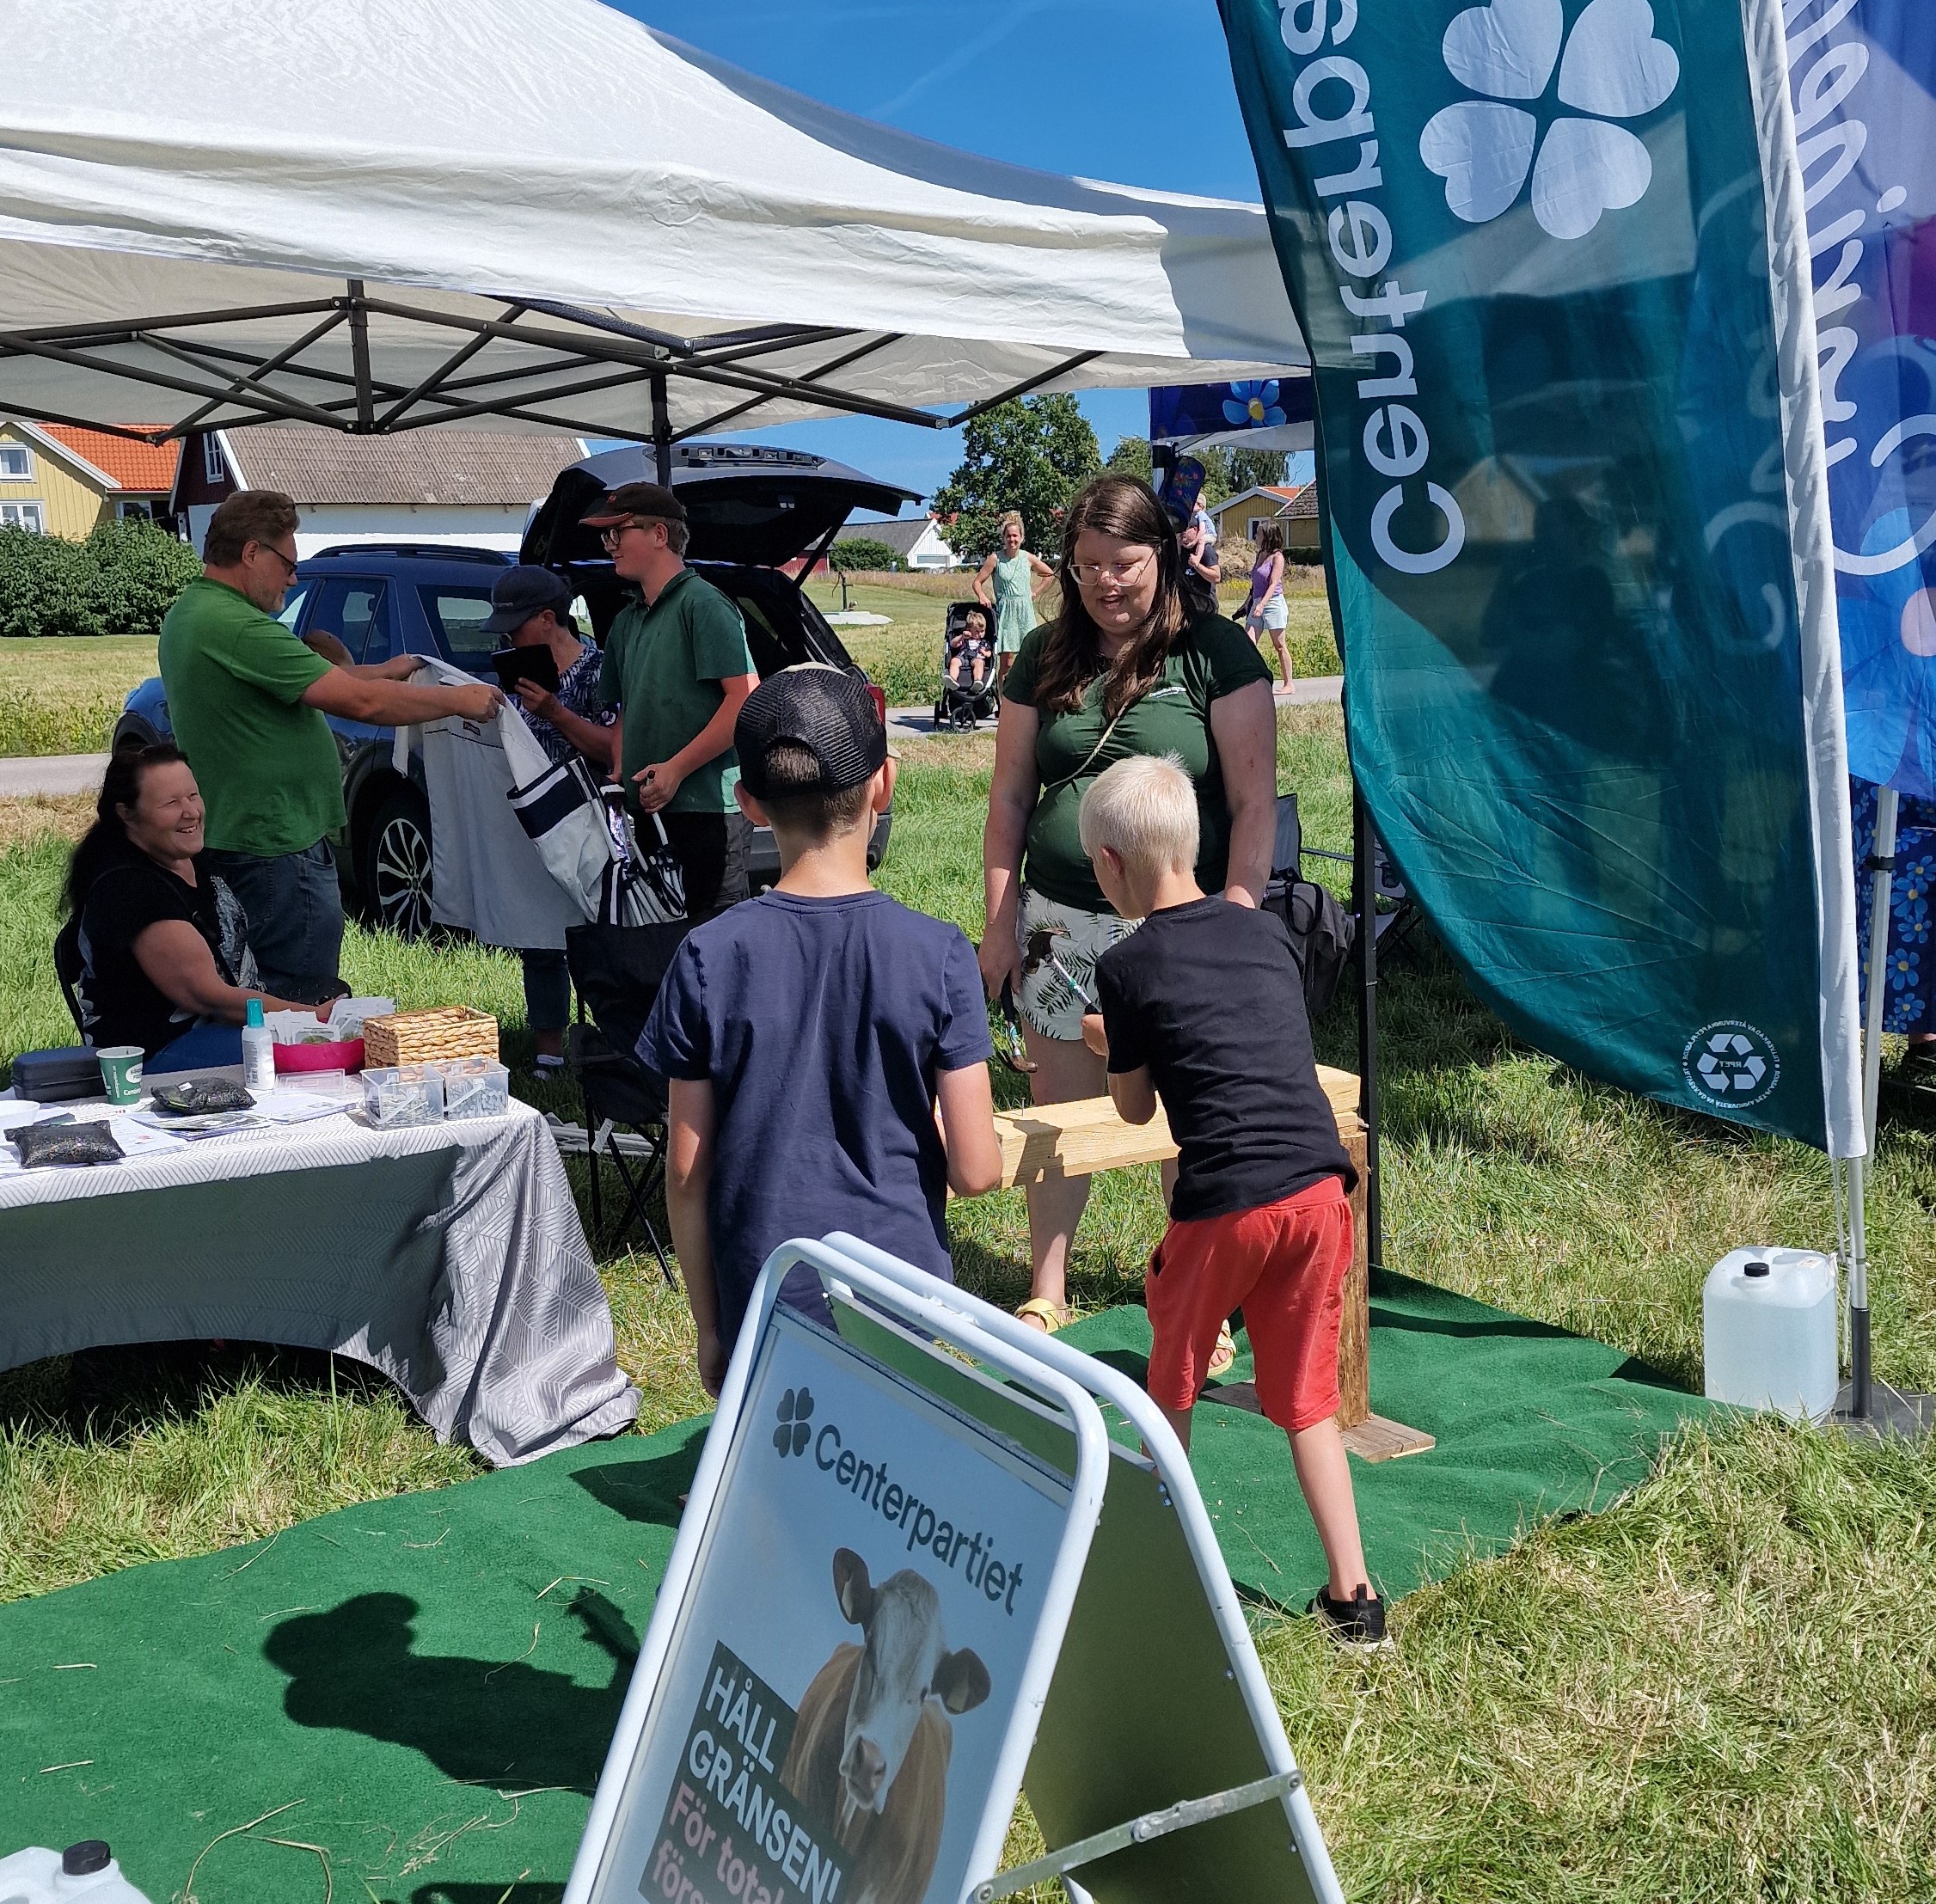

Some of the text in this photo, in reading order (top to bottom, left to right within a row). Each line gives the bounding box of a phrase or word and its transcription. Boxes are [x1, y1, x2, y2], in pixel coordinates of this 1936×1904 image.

[814, 1423, 1023, 1616] Centerpartiet
[705, 1666, 777, 1774] HÅLL
[669, 1780, 716, 1858] För
[689, 1730, 842, 1904] GRÄNSEN!
